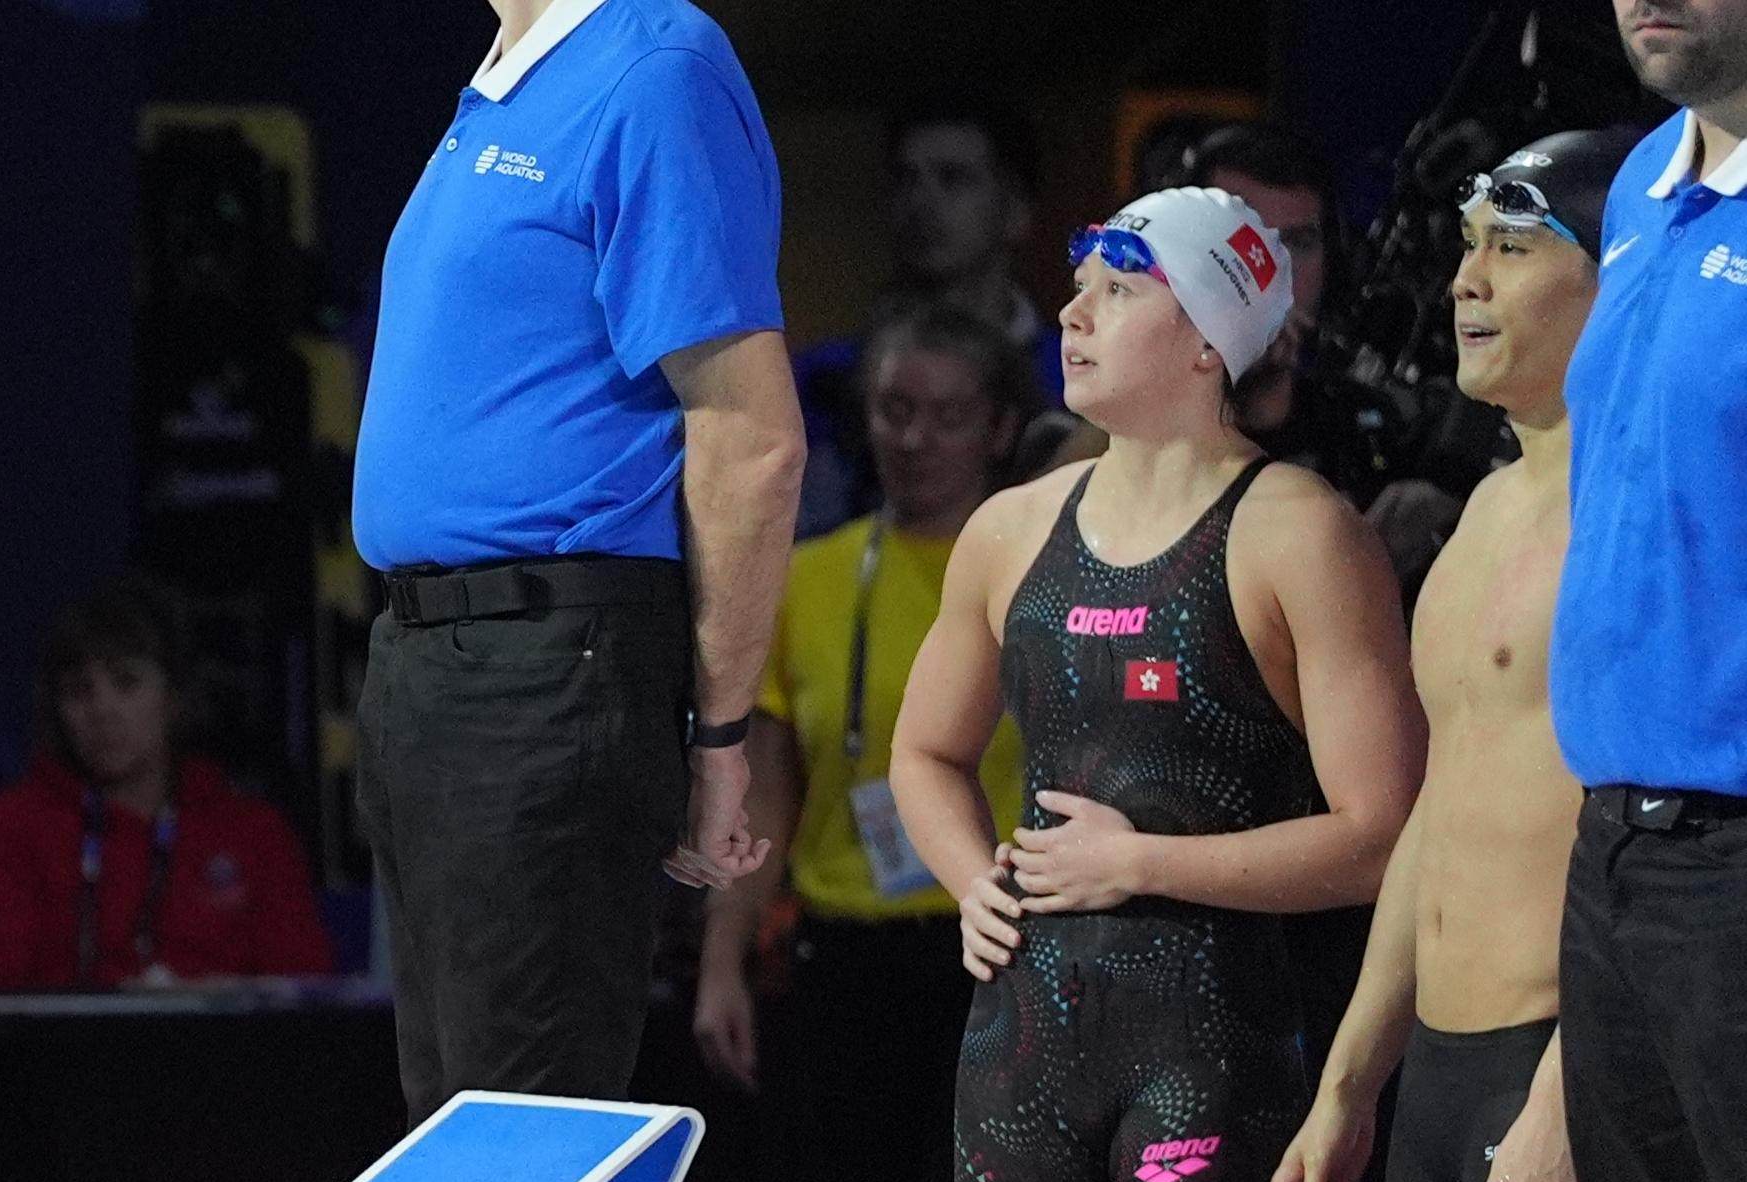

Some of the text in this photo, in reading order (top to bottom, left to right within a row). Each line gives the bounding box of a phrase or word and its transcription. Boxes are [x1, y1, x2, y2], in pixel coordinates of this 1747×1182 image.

[501, 151, 537, 167] WORLD
[494, 162, 546, 183] AQUATICS
[1209, 248, 1251, 306] HAUGHEY
[1066, 604, 1149, 636] arena
[1141, 1135, 1221, 1161] arena
